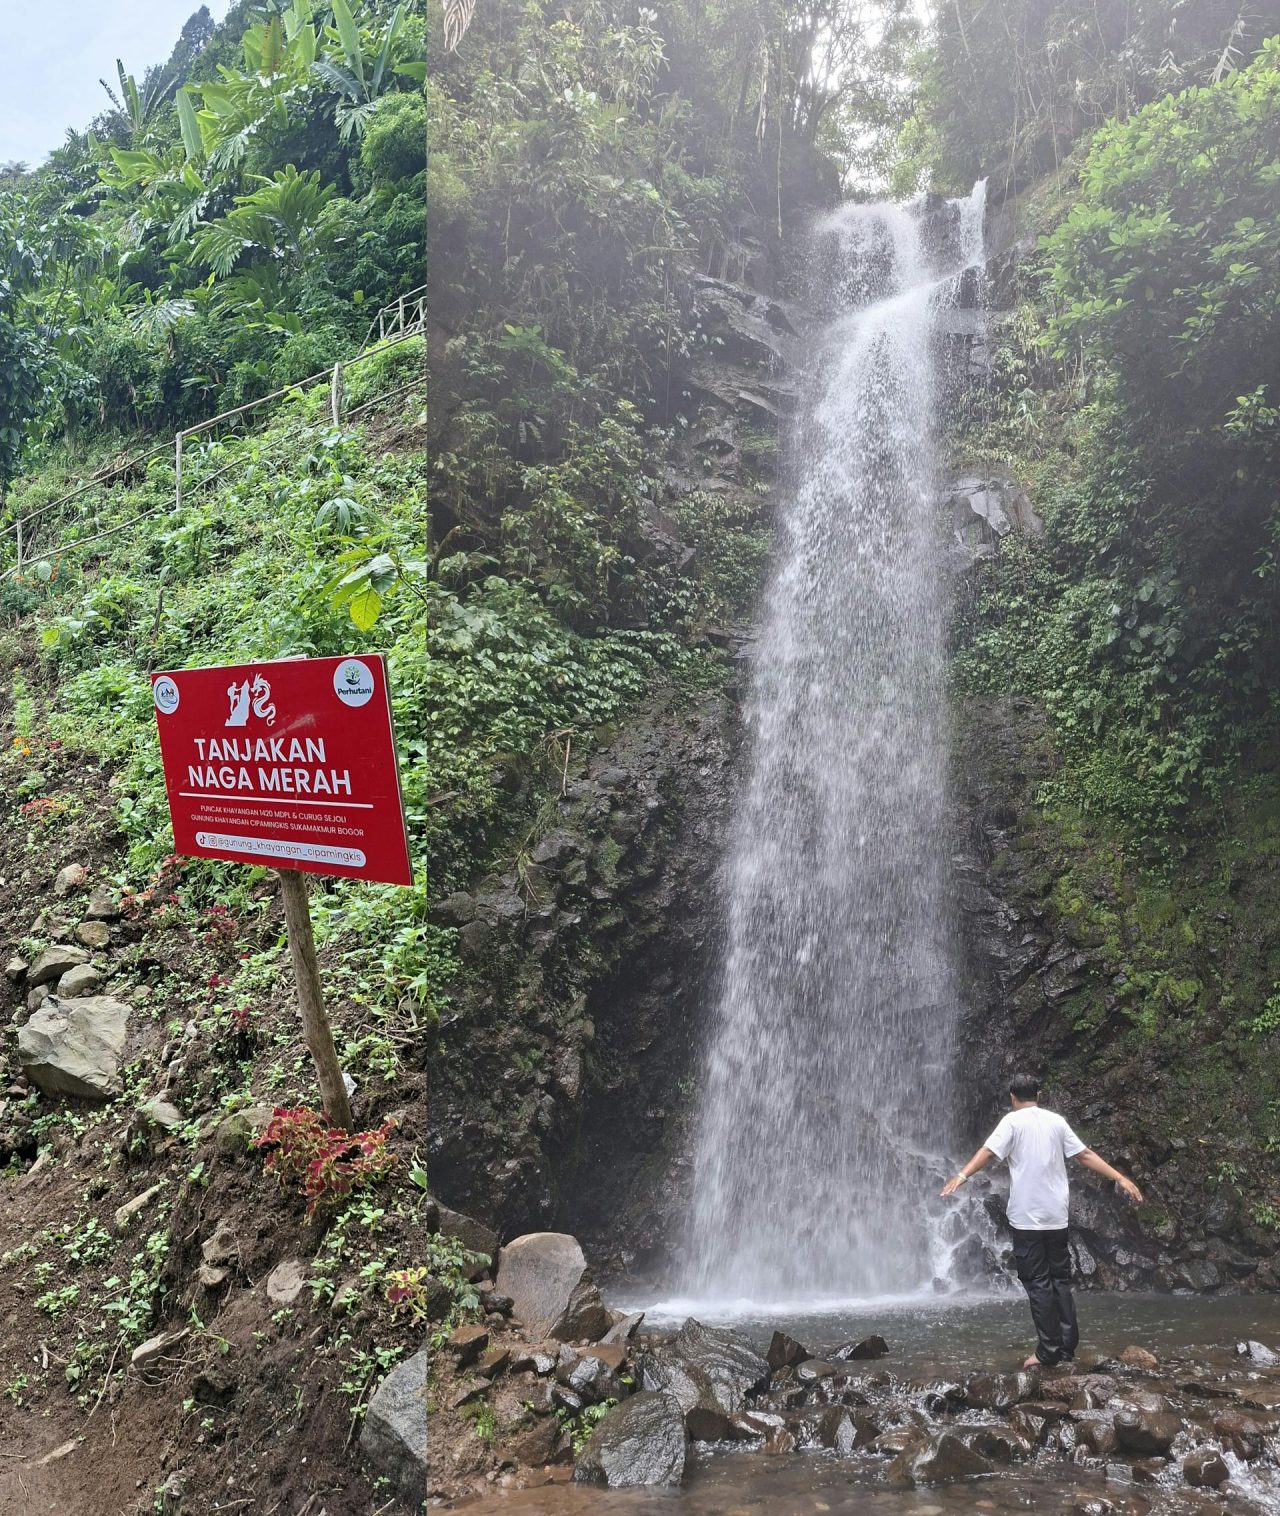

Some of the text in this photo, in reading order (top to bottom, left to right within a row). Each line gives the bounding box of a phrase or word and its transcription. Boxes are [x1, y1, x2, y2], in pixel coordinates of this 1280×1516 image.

[337, 687, 372, 695] Perhutani
[193, 738, 326, 763] TANJAKAN
[188, 765, 352, 795] NAGA MERAH
[191, 814, 364, 836] GUNUNG KHAYANGAN CIPAMINGKIS SUKAMAKMUR BOGOR
[223, 807, 259, 816] KHAYANGAN
[259, 809, 273, 817] 1420
[274, 811, 291, 819] MDPL
[299, 813, 322, 821] CURUG
[324, 814, 346, 823] SEJOLI
